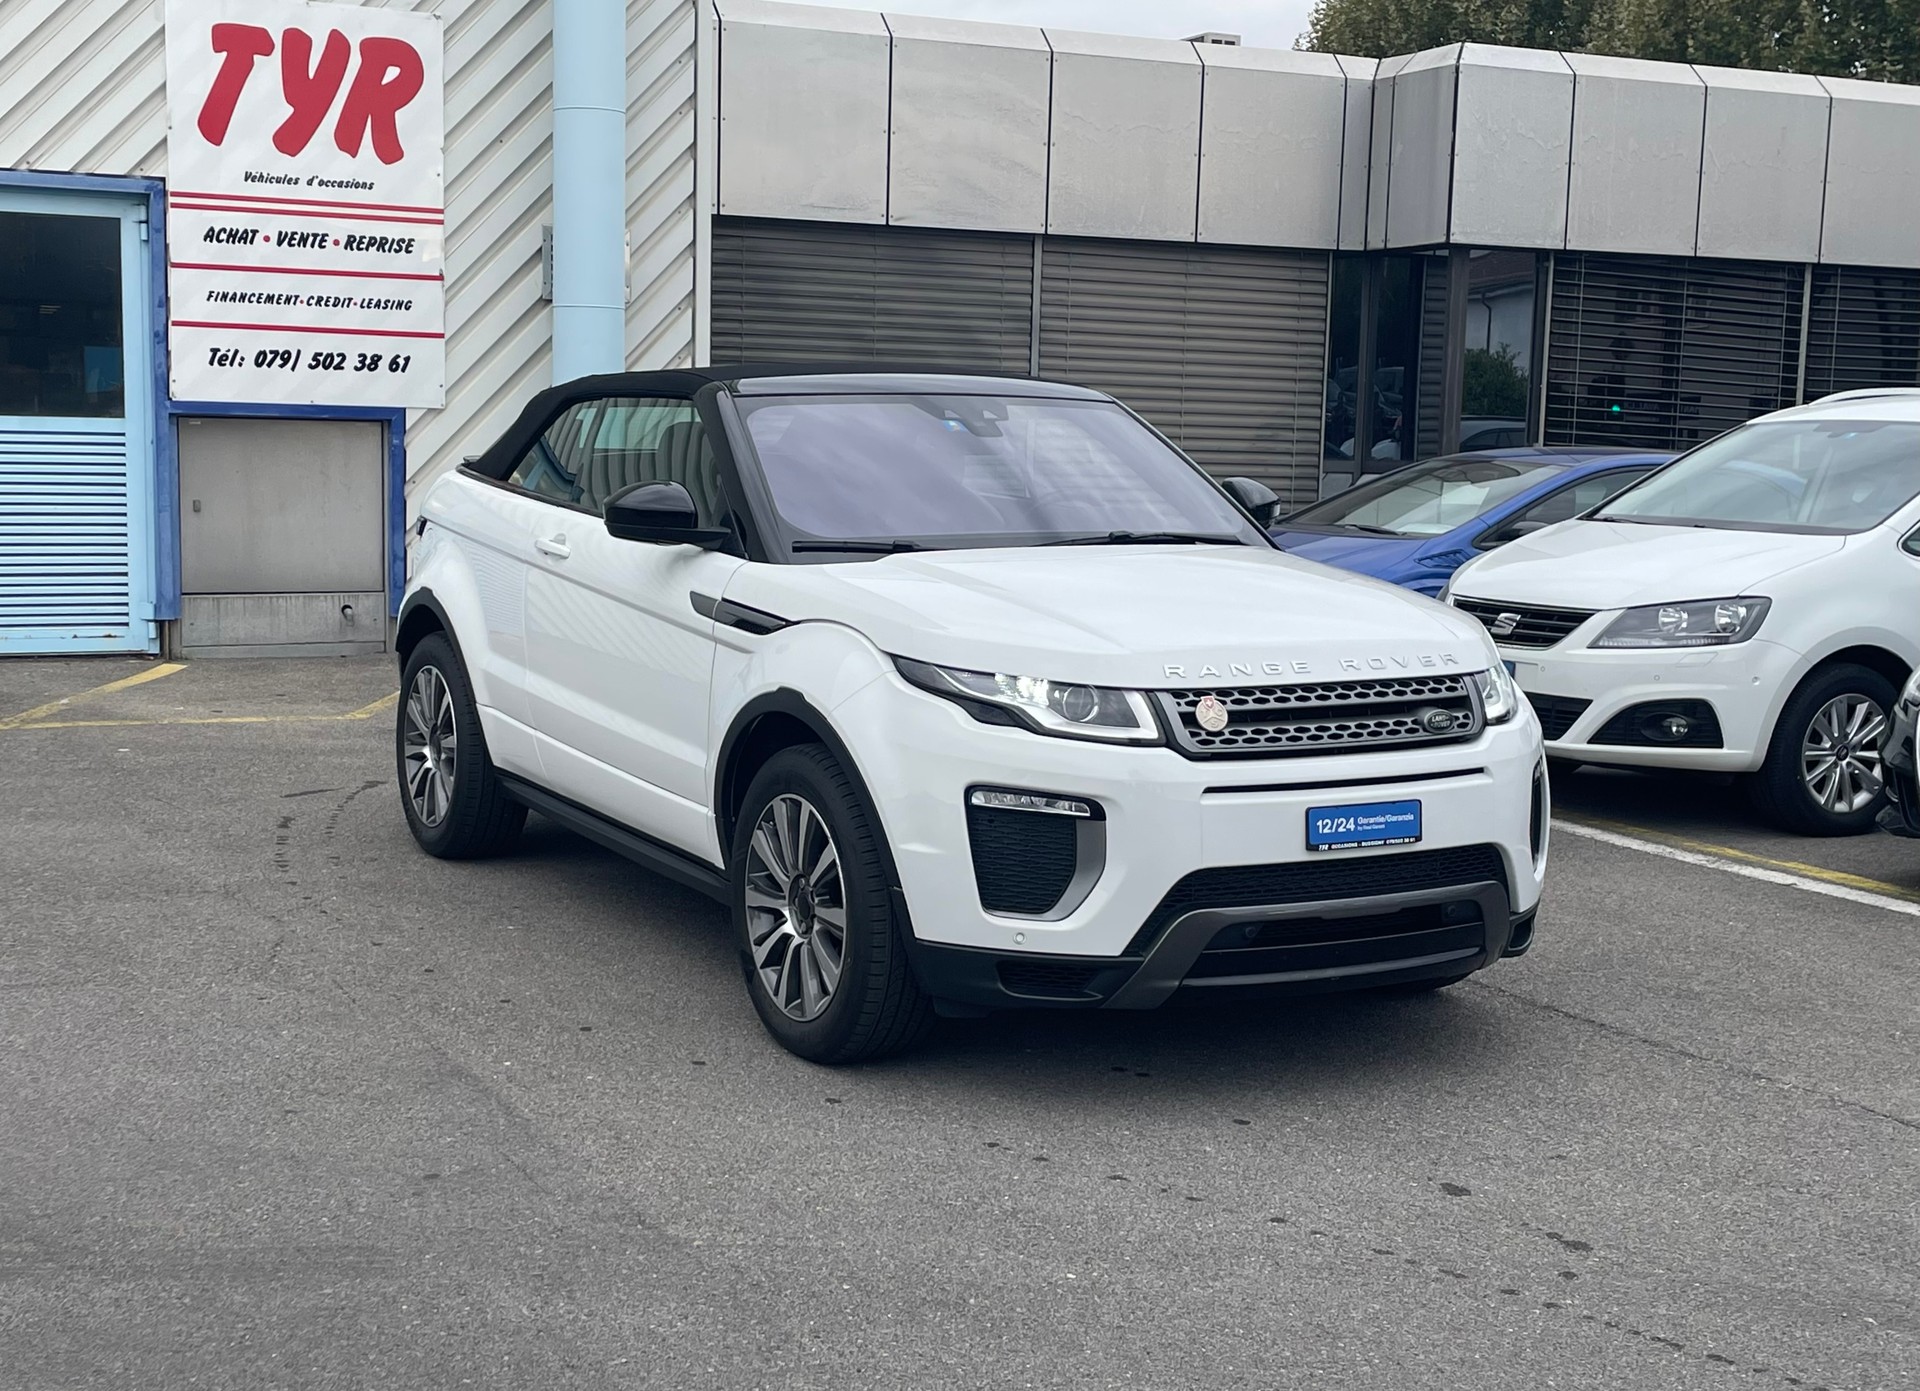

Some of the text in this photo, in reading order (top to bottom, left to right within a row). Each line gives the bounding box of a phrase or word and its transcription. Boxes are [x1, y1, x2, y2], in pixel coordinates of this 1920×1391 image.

[197, 22, 425, 166] TYR
[243, 170, 375, 191] Véhicules d'occasions
[203, 226, 416, 255] ACHAT VENTE REPRISE
[206, 290, 413, 312] FINANCEMENT CREDIT LEASING
[208, 347, 245, 368] Tél:
[307, 351, 347, 371] 502
[353, 353, 383, 372] 38
[388, 354, 411, 373] 61
[1162, 652, 1460, 679] RANGE ROVER
[1316, 816, 1355, 834] 12/24
